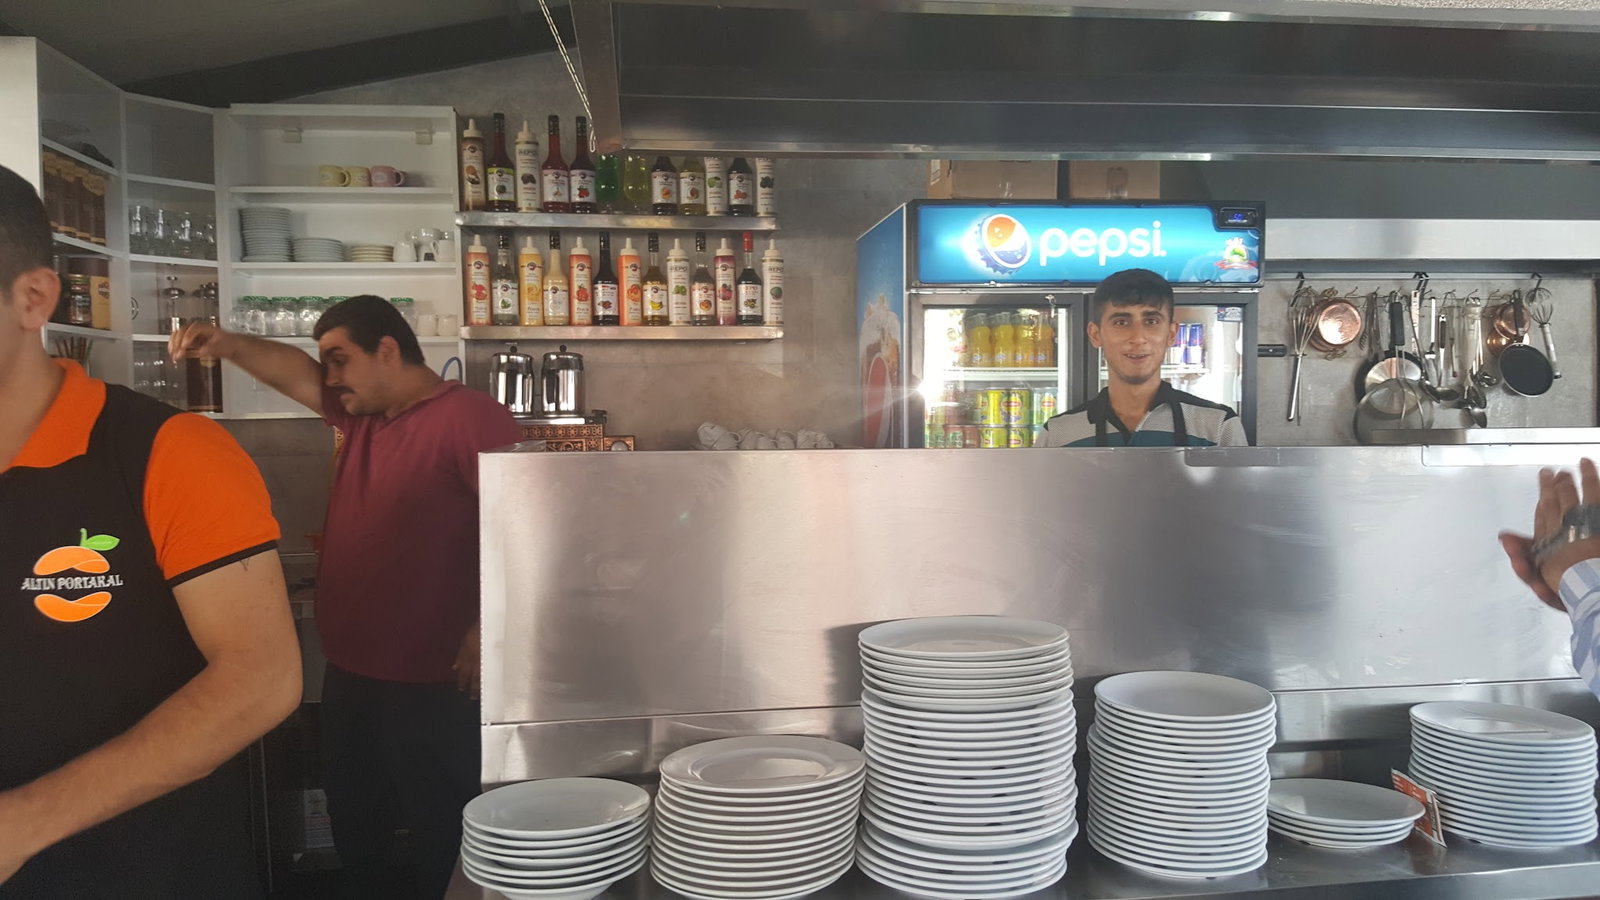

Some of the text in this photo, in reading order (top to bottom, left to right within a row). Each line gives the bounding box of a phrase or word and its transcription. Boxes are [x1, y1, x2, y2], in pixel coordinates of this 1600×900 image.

[1039, 220, 1164, 266] pepsi
[21, 574, 123, 590] ALTIN PORTAKAL
